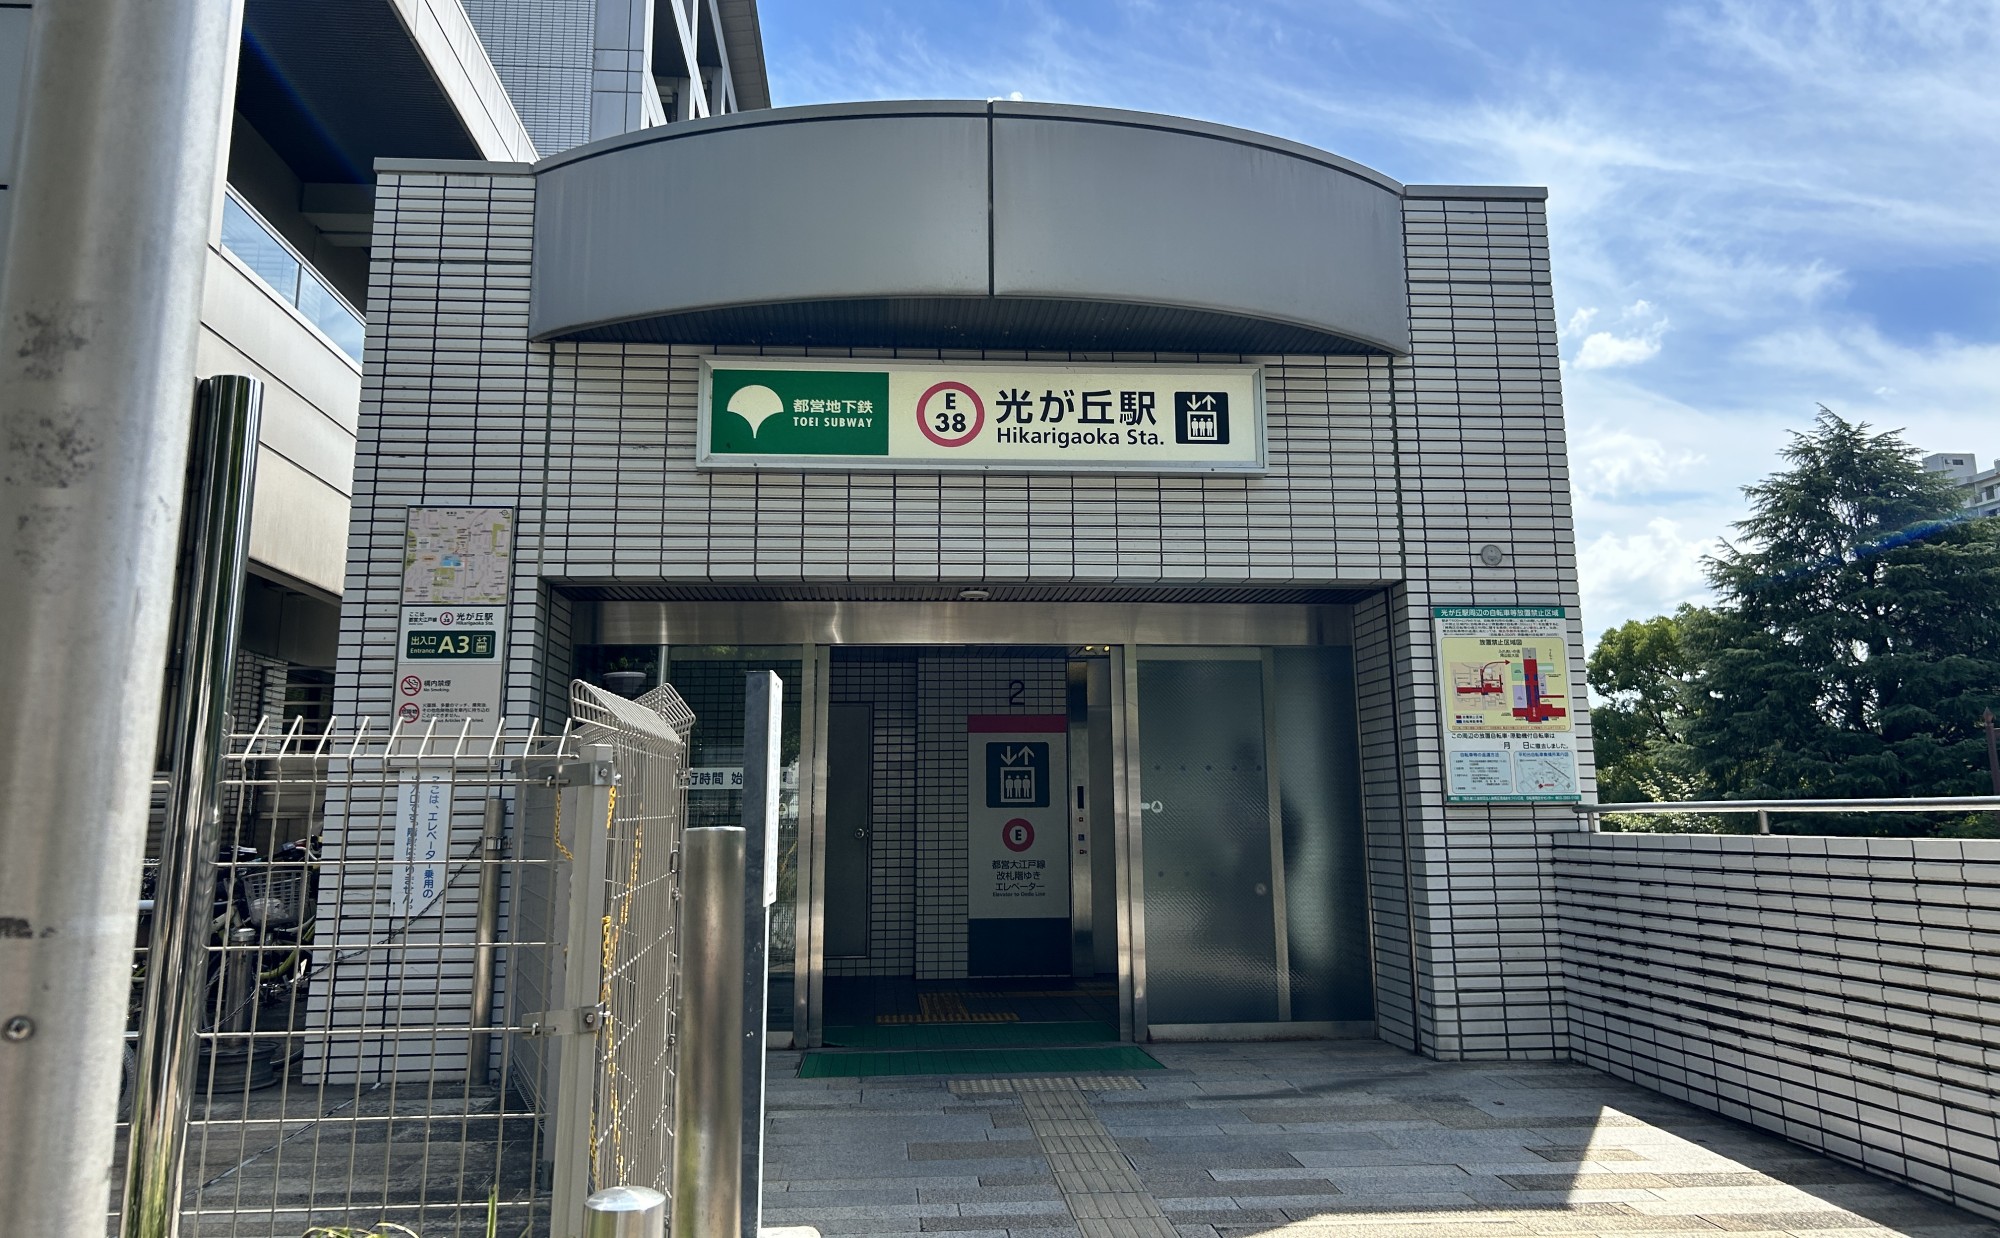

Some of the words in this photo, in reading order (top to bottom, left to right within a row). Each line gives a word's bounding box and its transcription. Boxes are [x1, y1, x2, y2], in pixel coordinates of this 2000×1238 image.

[793, 398, 873, 415] 都営地下鉄
[945, 392, 957, 410] E
[996, 389, 1158, 426] 光が丘駅
[793, 417, 819, 427] TOEI
[823, 417, 873, 428] SUBWAY
[934, 413, 967, 433] 38
[997, 427, 1120, 449] Hikarigaoka
[1127, 428, 1165, 446] Sta.
[456, 612, 494, 621] 光が丘駅
[1440, 609, 1559, 617] 光が丘駅周辺の自転車等放置禁止区域
[411, 636, 437, 646] 出入口
[438, 636, 470, 654] A3
[1008, 679, 1025, 706] 2
[1504, 742, 1510, 750] 月
[681, 771, 724, 786] 行時間
[1014, 829, 1022, 840] E
[992, 860, 1046, 870] 都営大江戸線
[996, 871, 1041, 880] 改札階ゆき
[995, 882, 1045, 891] エレベーター
